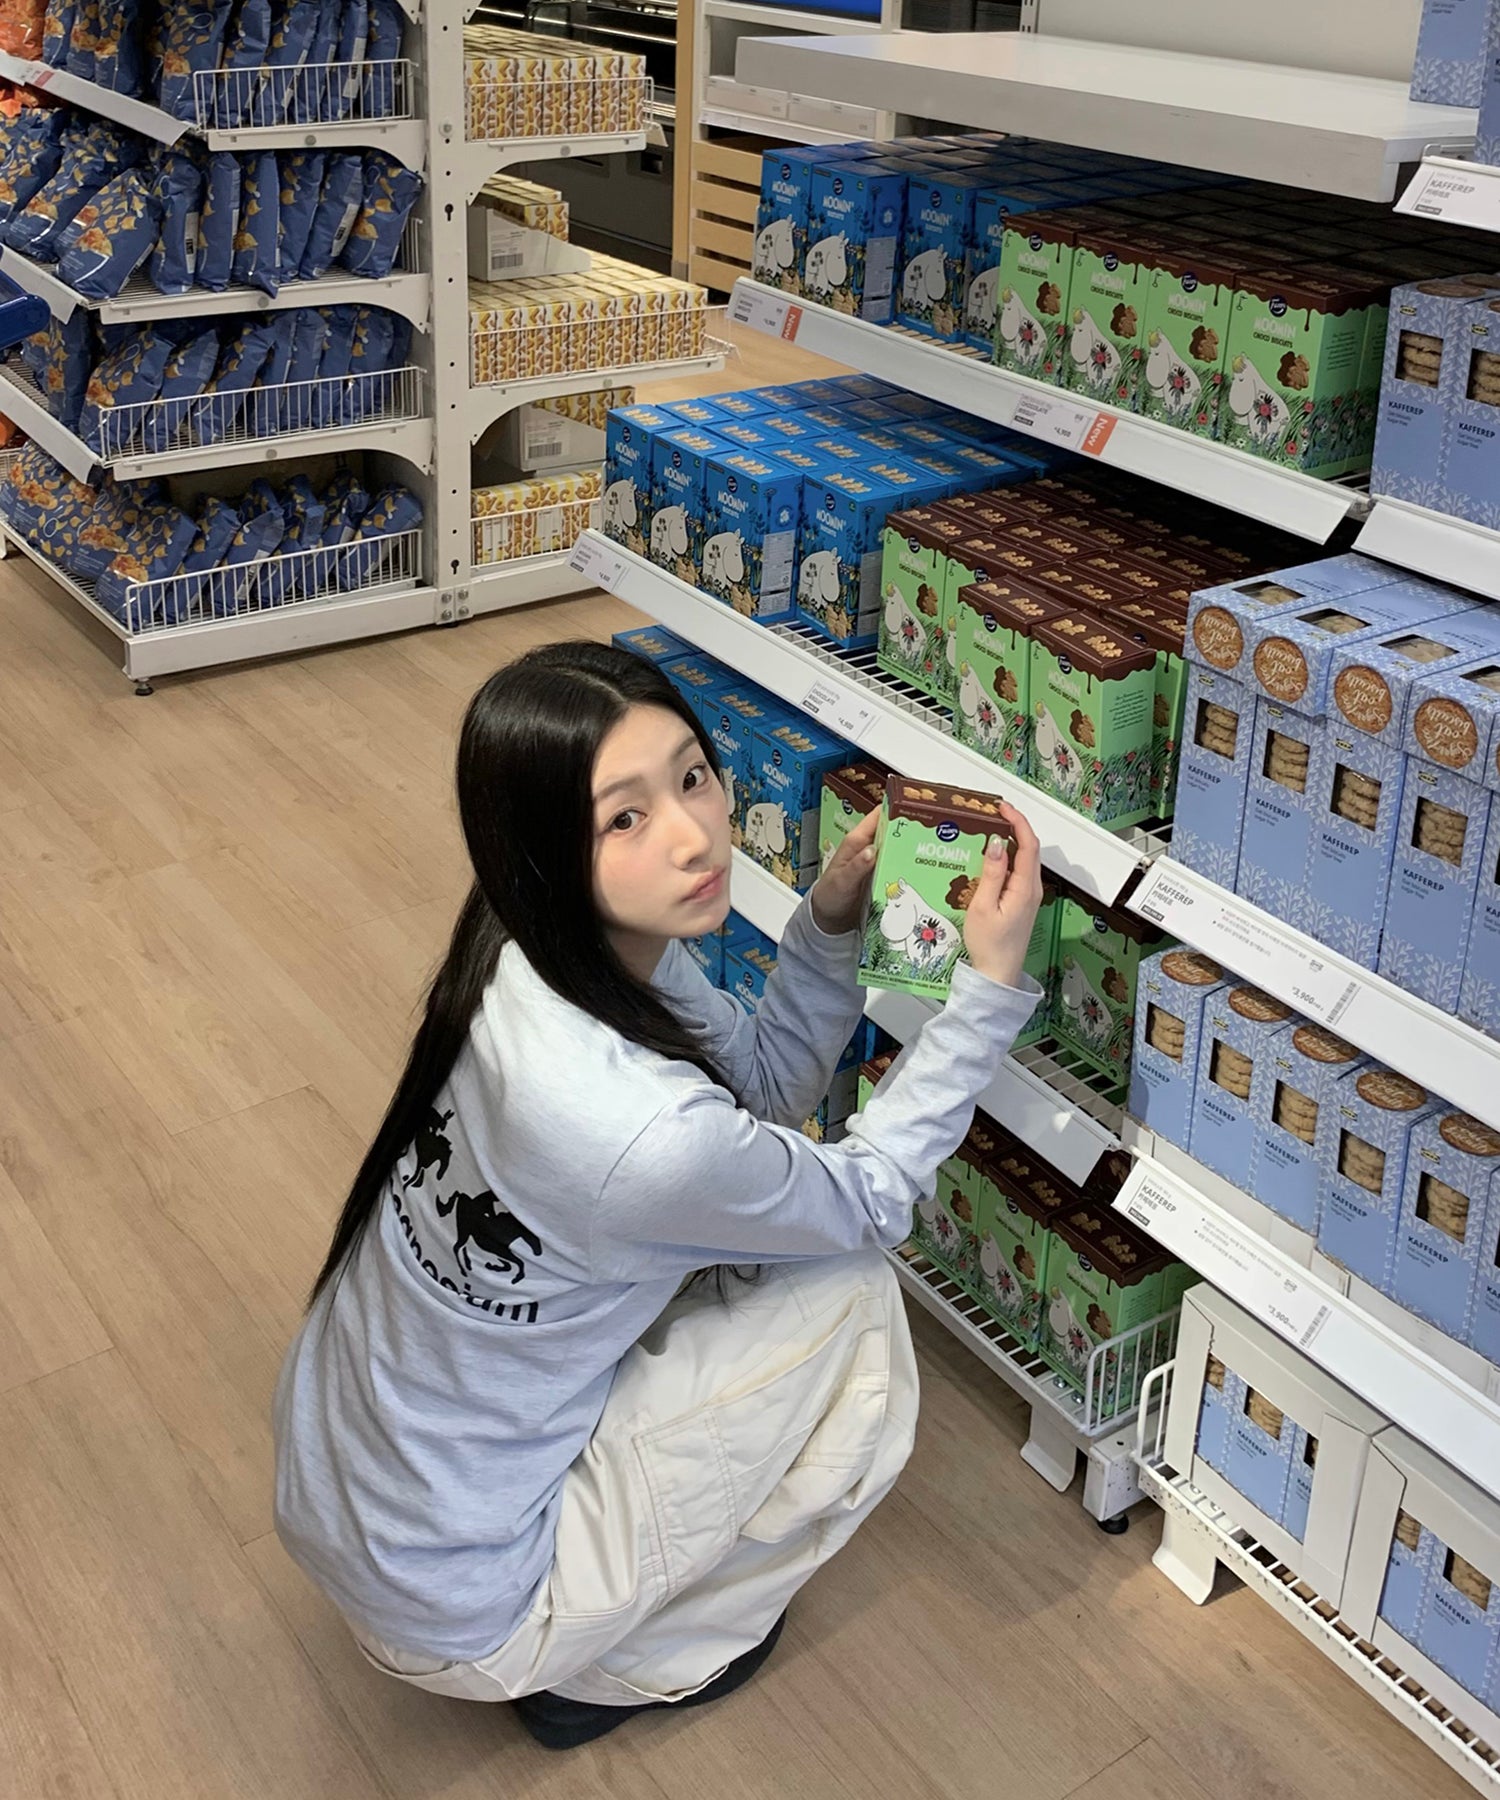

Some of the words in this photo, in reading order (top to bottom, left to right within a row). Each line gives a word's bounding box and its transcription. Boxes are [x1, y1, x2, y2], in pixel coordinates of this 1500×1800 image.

[1429, 179, 1476, 194] KAFFEREP
[783, 313, 796, 339] New
[1253, 331, 1269, 343] CHOCO
[1271, 335, 1293, 349] BISCUITS
[1020, 401, 1048, 415] CHOCOLATE
[1388, 401, 1424, 416] KAFFEREP
[1088, 417, 1108, 447] New
[1459, 422, 1495, 438] KAFFEREP
[718, 490, 746, 512] MOOMIN
[816, 508, 843, 531] MOOMIN
[812, 688, 836, 705] CHOCOLATE
[712, 728, 739, 752] MOOMIN
[762, 760, 790, 788] MOOMIN
[1188, 764, 1221, 784] KAFFEREP
[1256, 797, 1291, 819] KAFFEREP
[916, 842, 971, 863] MOOMIN
[1322, 833, 1359, 856] KAFFEREP
[915, 857, 937, 867] CHOCO
[938, 861, 966, 872] BISCUITS
[1403, 867, 1444, 892] KAFFEREP
[1157, 882, 1194, 906] KAFFEREP
[1140, 1061, 1170, 1083] KAFFEREP
[1203, 1098, 1236, 1123] KAFFEREP
[1265, 1139, 1300, 1165] KAFFEREP
[1142, 1184, 1177, 1212] KAFFEREP
[1331, 1192, 1367, 1217] KAFFEREP
[1408, 1236, 1448, 1263] KAFFEREP
[1237, 1430, 1267, 1456] KAFFEREP
[1435, 1593, 1471, 1624] KAFFEREP
